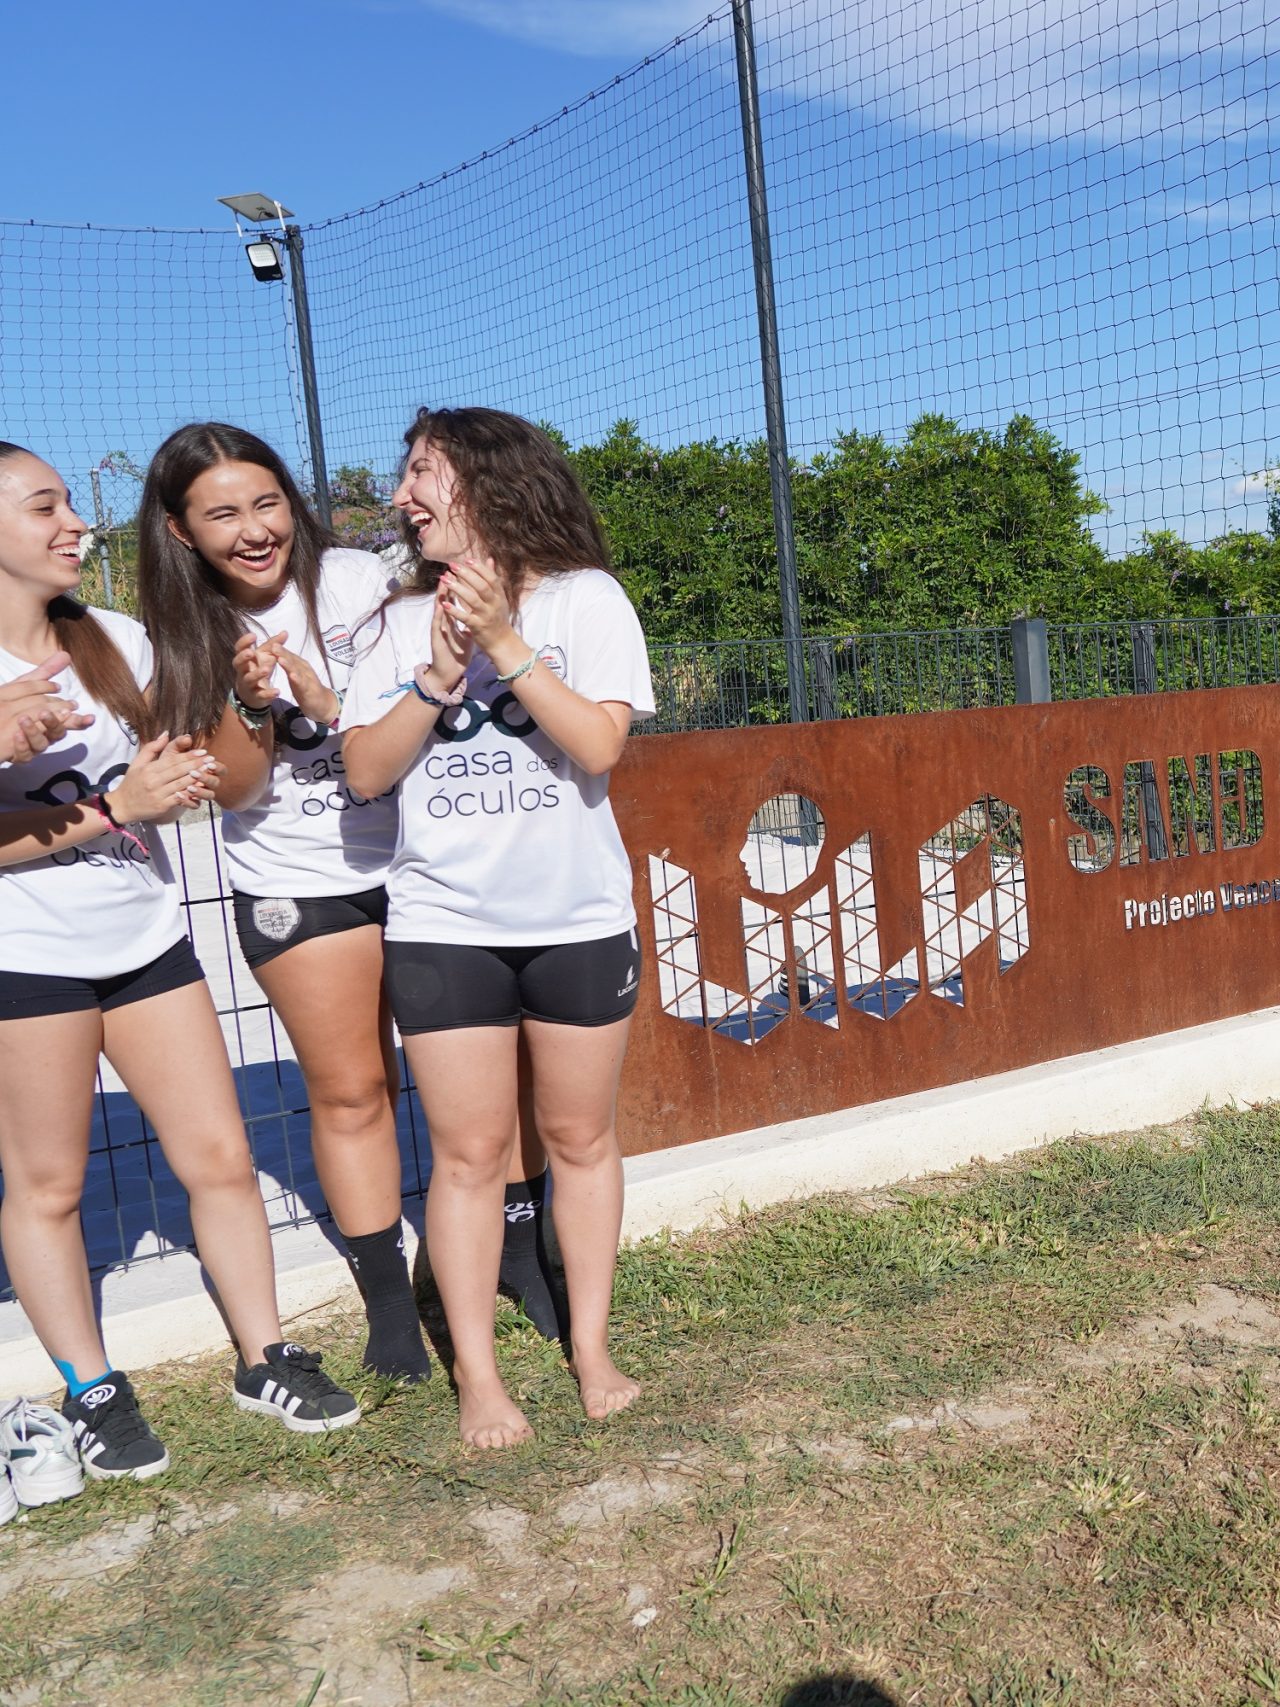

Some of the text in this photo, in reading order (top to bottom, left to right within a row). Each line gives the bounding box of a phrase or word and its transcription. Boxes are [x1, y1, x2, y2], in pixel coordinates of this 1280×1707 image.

[292, 751, 346, 785] cas
[425, 750, 558, 780] casa dos
[427, 780, 560, 819] óculos
[1063, 747, 1265, 874] SAND
[1124, 888, 1216, 931] Projecto
